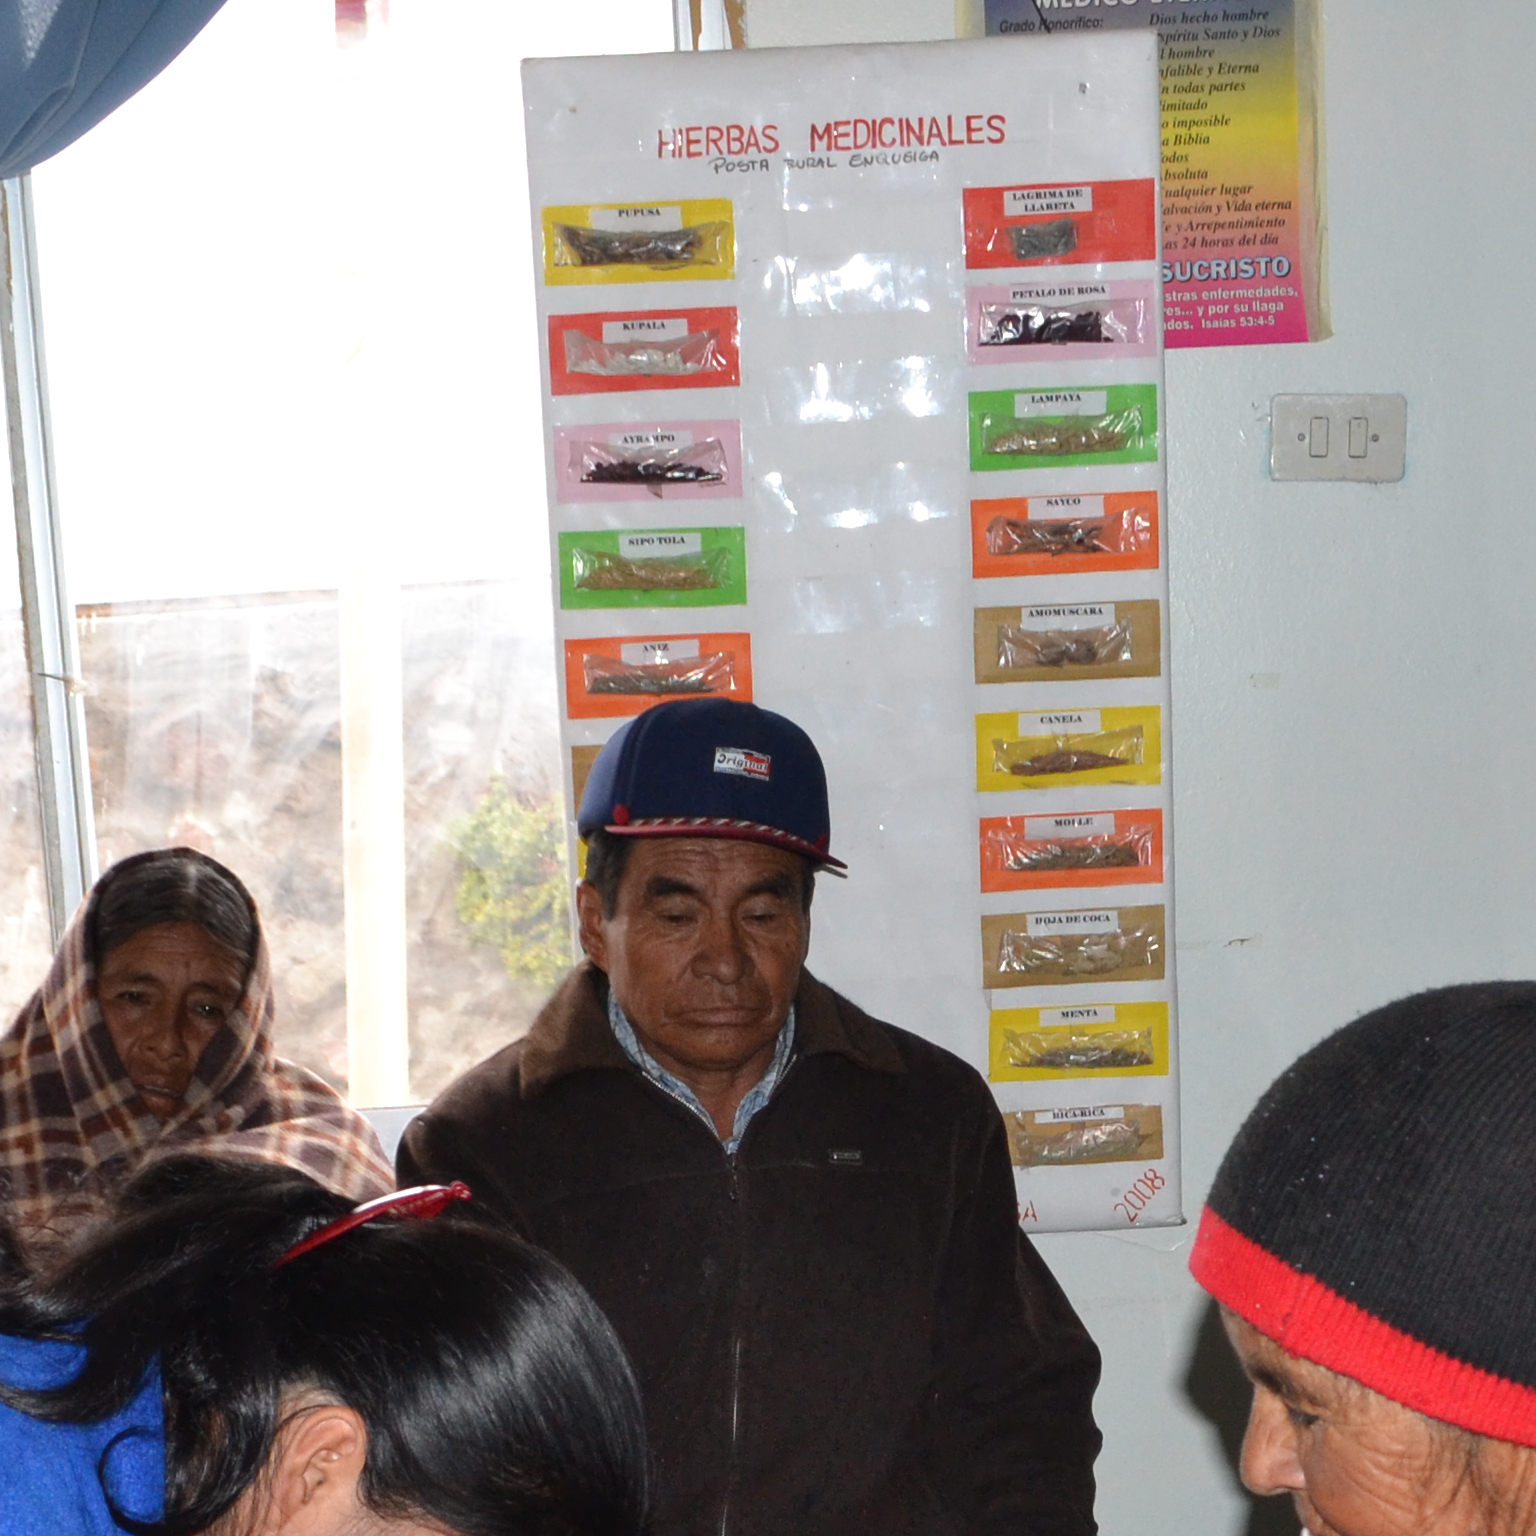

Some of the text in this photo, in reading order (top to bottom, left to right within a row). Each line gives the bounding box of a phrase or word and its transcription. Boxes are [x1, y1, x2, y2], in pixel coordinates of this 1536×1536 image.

[1149, 9, 1270, 26] Dios hecho hombre
[999, 18, 1035, 33] Grado
[1204, 28, 1238, 40] Santo
[1242, 30, 1249, 43] y
[1253, 26, 1281, 38] Dios
[1168, 46, 1215, 59] hombre
[1206, 67, 1214, 78] y
[1218, 62, 1260, 75] Eterna
[1173, 81, 1205, 94] todas
[1209, 81, 1246, 96] partes
[1172, 114, 1231, 131] imposible
[657, 114, 1007, 159] HIERBAS MEDICINALES
[1173, 134, 1210, 147] Biblia
[713, 156, 770, 174] POSTA
[786, 153, 838, 171] RURAL
[1161, 152, 1189, 164] odos
[1161, 168, 1208, 181] bsoluta
[1012, 188, 1083, 201] LAGRIMA DE
[1162, 184, 1253, 200] ualquier lugar
[617, 208, 661, 218] PUPUSA
[1023, 201, 1076, 213] LLARETA
[1162, 200, 1292, 217] alvación y Vida eterna
[1177, 224, 1185, 236] y
[1185, 217, 1286, 234] Arrepentimiento
[1182, 237, 1196, 250] 24
[1201, 235, 1234, 248] horas
[1238, 234, 1256, 247] del
[1259, 233, 1279, 246] día
[1011, 284, 1107, 300] PETALO DE ROSA
[1202, 284, 1299, 301] enfermedades,
[1197, 305, 1205, 318] y
[1208, 302, 1230, 317] por
[1234, 303, 1250, 313] su
[1252, 299, 1285, 316] llaga
[622, 320, 666, 331] KUPALA
[1201, 316, 1237, 329] Isaías
[1240, 314, 1276, 327] 53:4-5
[1031, 392, 1083, 404] LAMPAYA
[621, 433, 677, 445] AYRAMPO
[656, 535, 686, 546] TOLA
[1039, 714, 1084, 725] CANELA
[1054, 817, 1094, 828] MOLLE
[1034, 913, 1112, 926] HOJA DE COCA
[1060, 1008, 1099, 1019] MENTA
[1114, 1167, 1167, 1224] 2008
